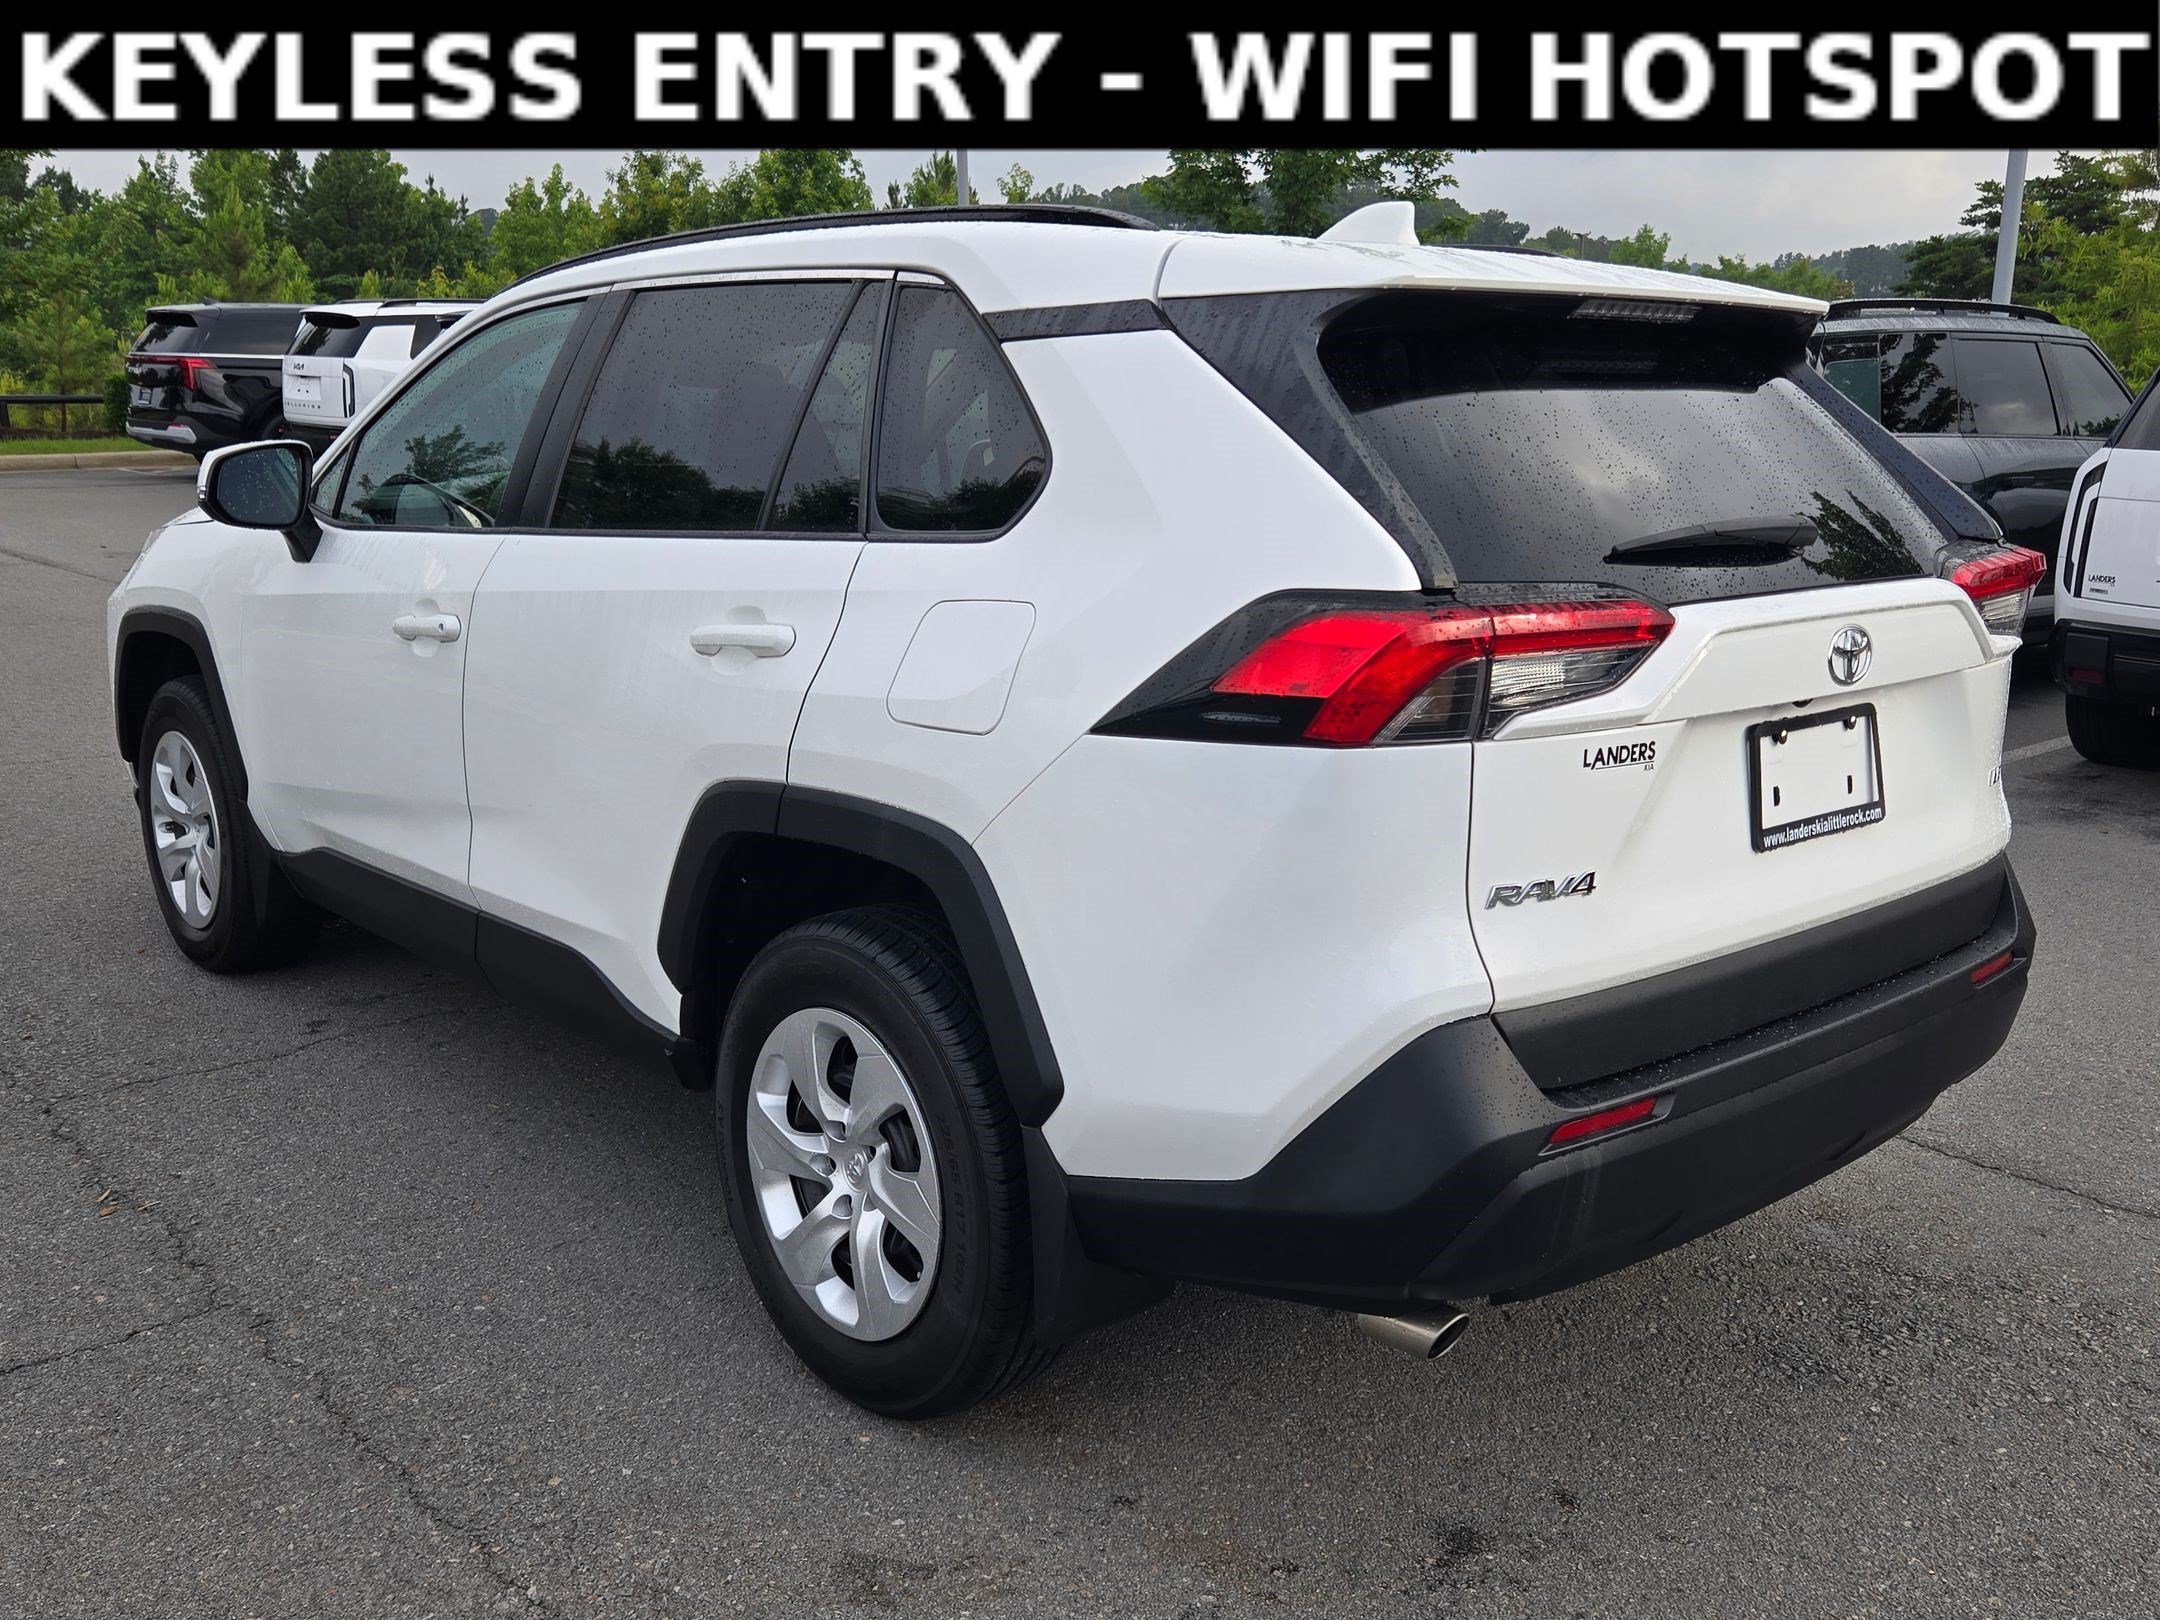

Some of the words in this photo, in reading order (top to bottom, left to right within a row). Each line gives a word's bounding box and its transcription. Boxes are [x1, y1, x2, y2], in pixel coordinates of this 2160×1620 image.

[2088, 574, 2116, 584] LANDERS
[1583, 741, 1656, 770] LANDERS
[1763, 807, 1883, 848] www.landerskialittlerock.com
[1484, 870, 1597, 910] RAV4
